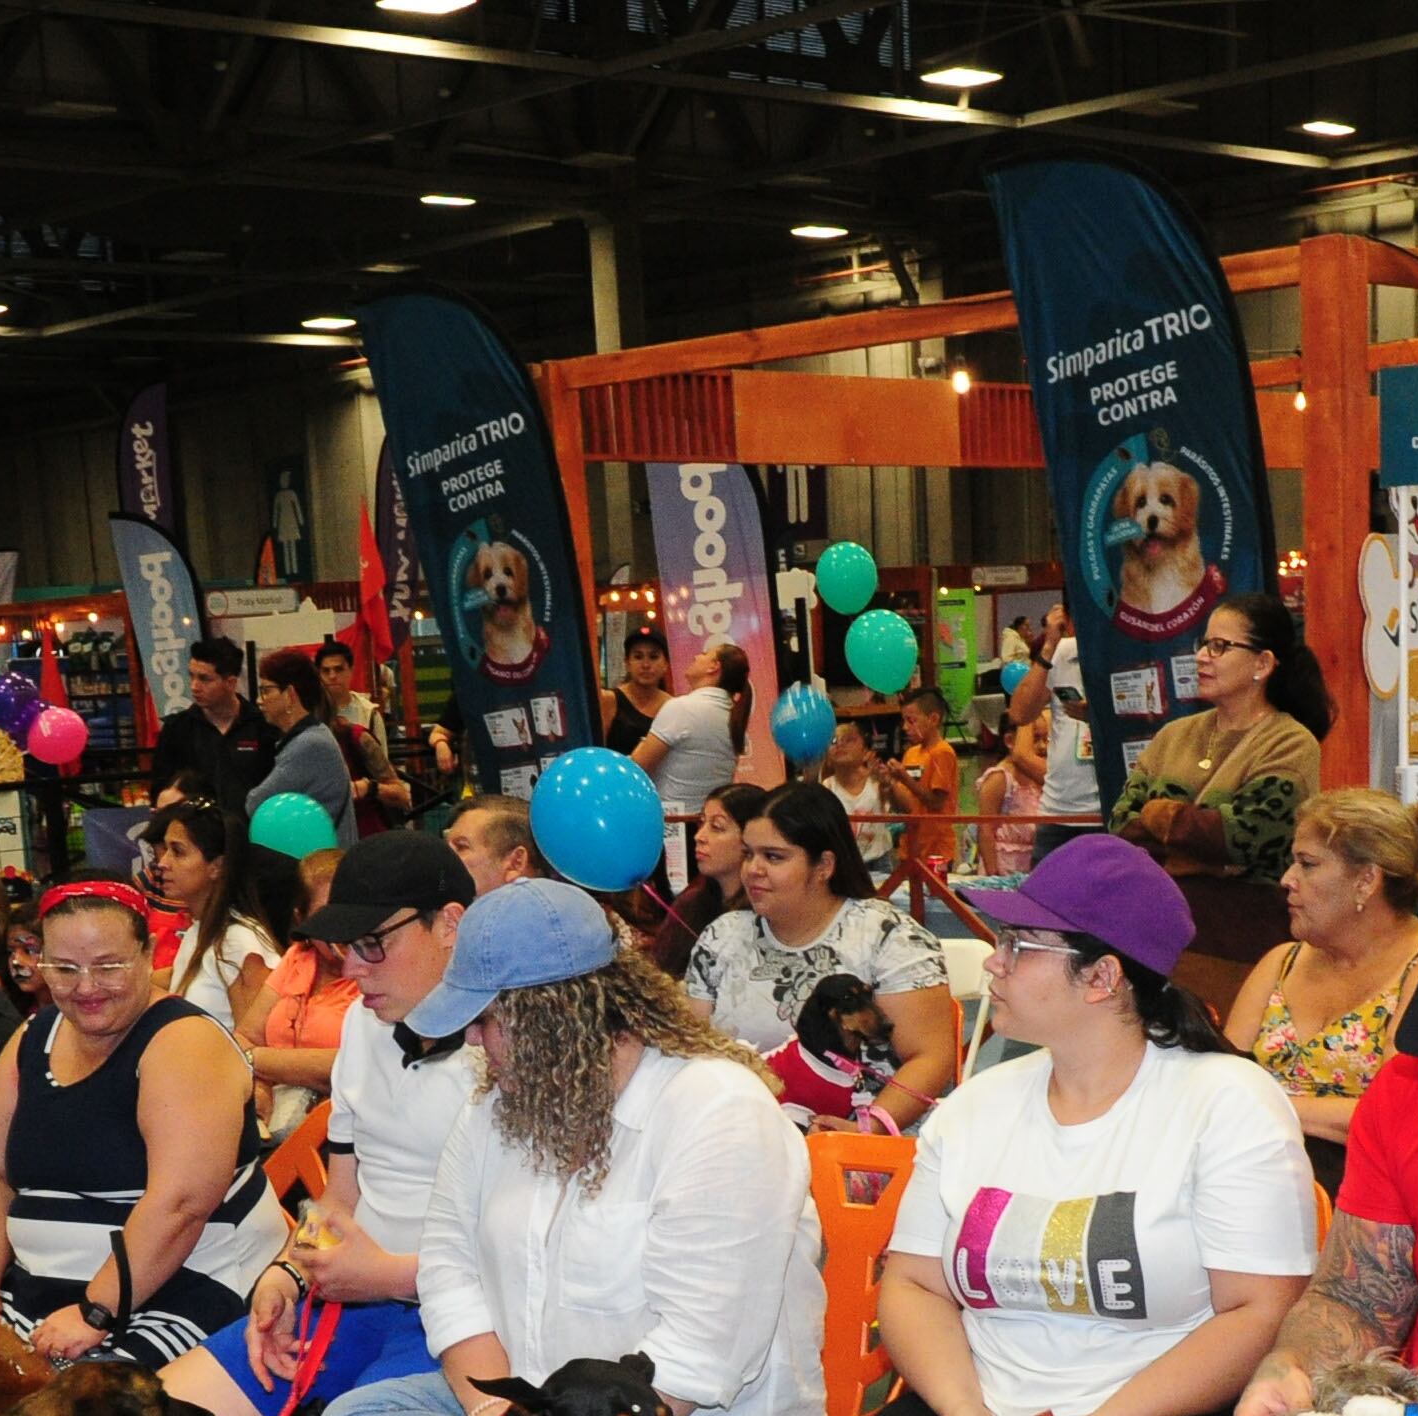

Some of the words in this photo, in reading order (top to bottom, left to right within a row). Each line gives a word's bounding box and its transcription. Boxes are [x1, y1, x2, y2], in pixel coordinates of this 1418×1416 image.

[1046, 328, 1144, 384] Simparica
[1144, 304, 1212, 344] TRIO
[1090, 360, 1179, 406] PROTEGE
[1098, 385, 1178, 426] CONTRA
[406, 432, 479, 479] Simparica
[476, 412, 526, 447] TRIO
[441, 458, 505, 497] PROTEGE
[448, 479, 506, 514] CONTRA
[957, 1247, 1135, 1310] LOVE
